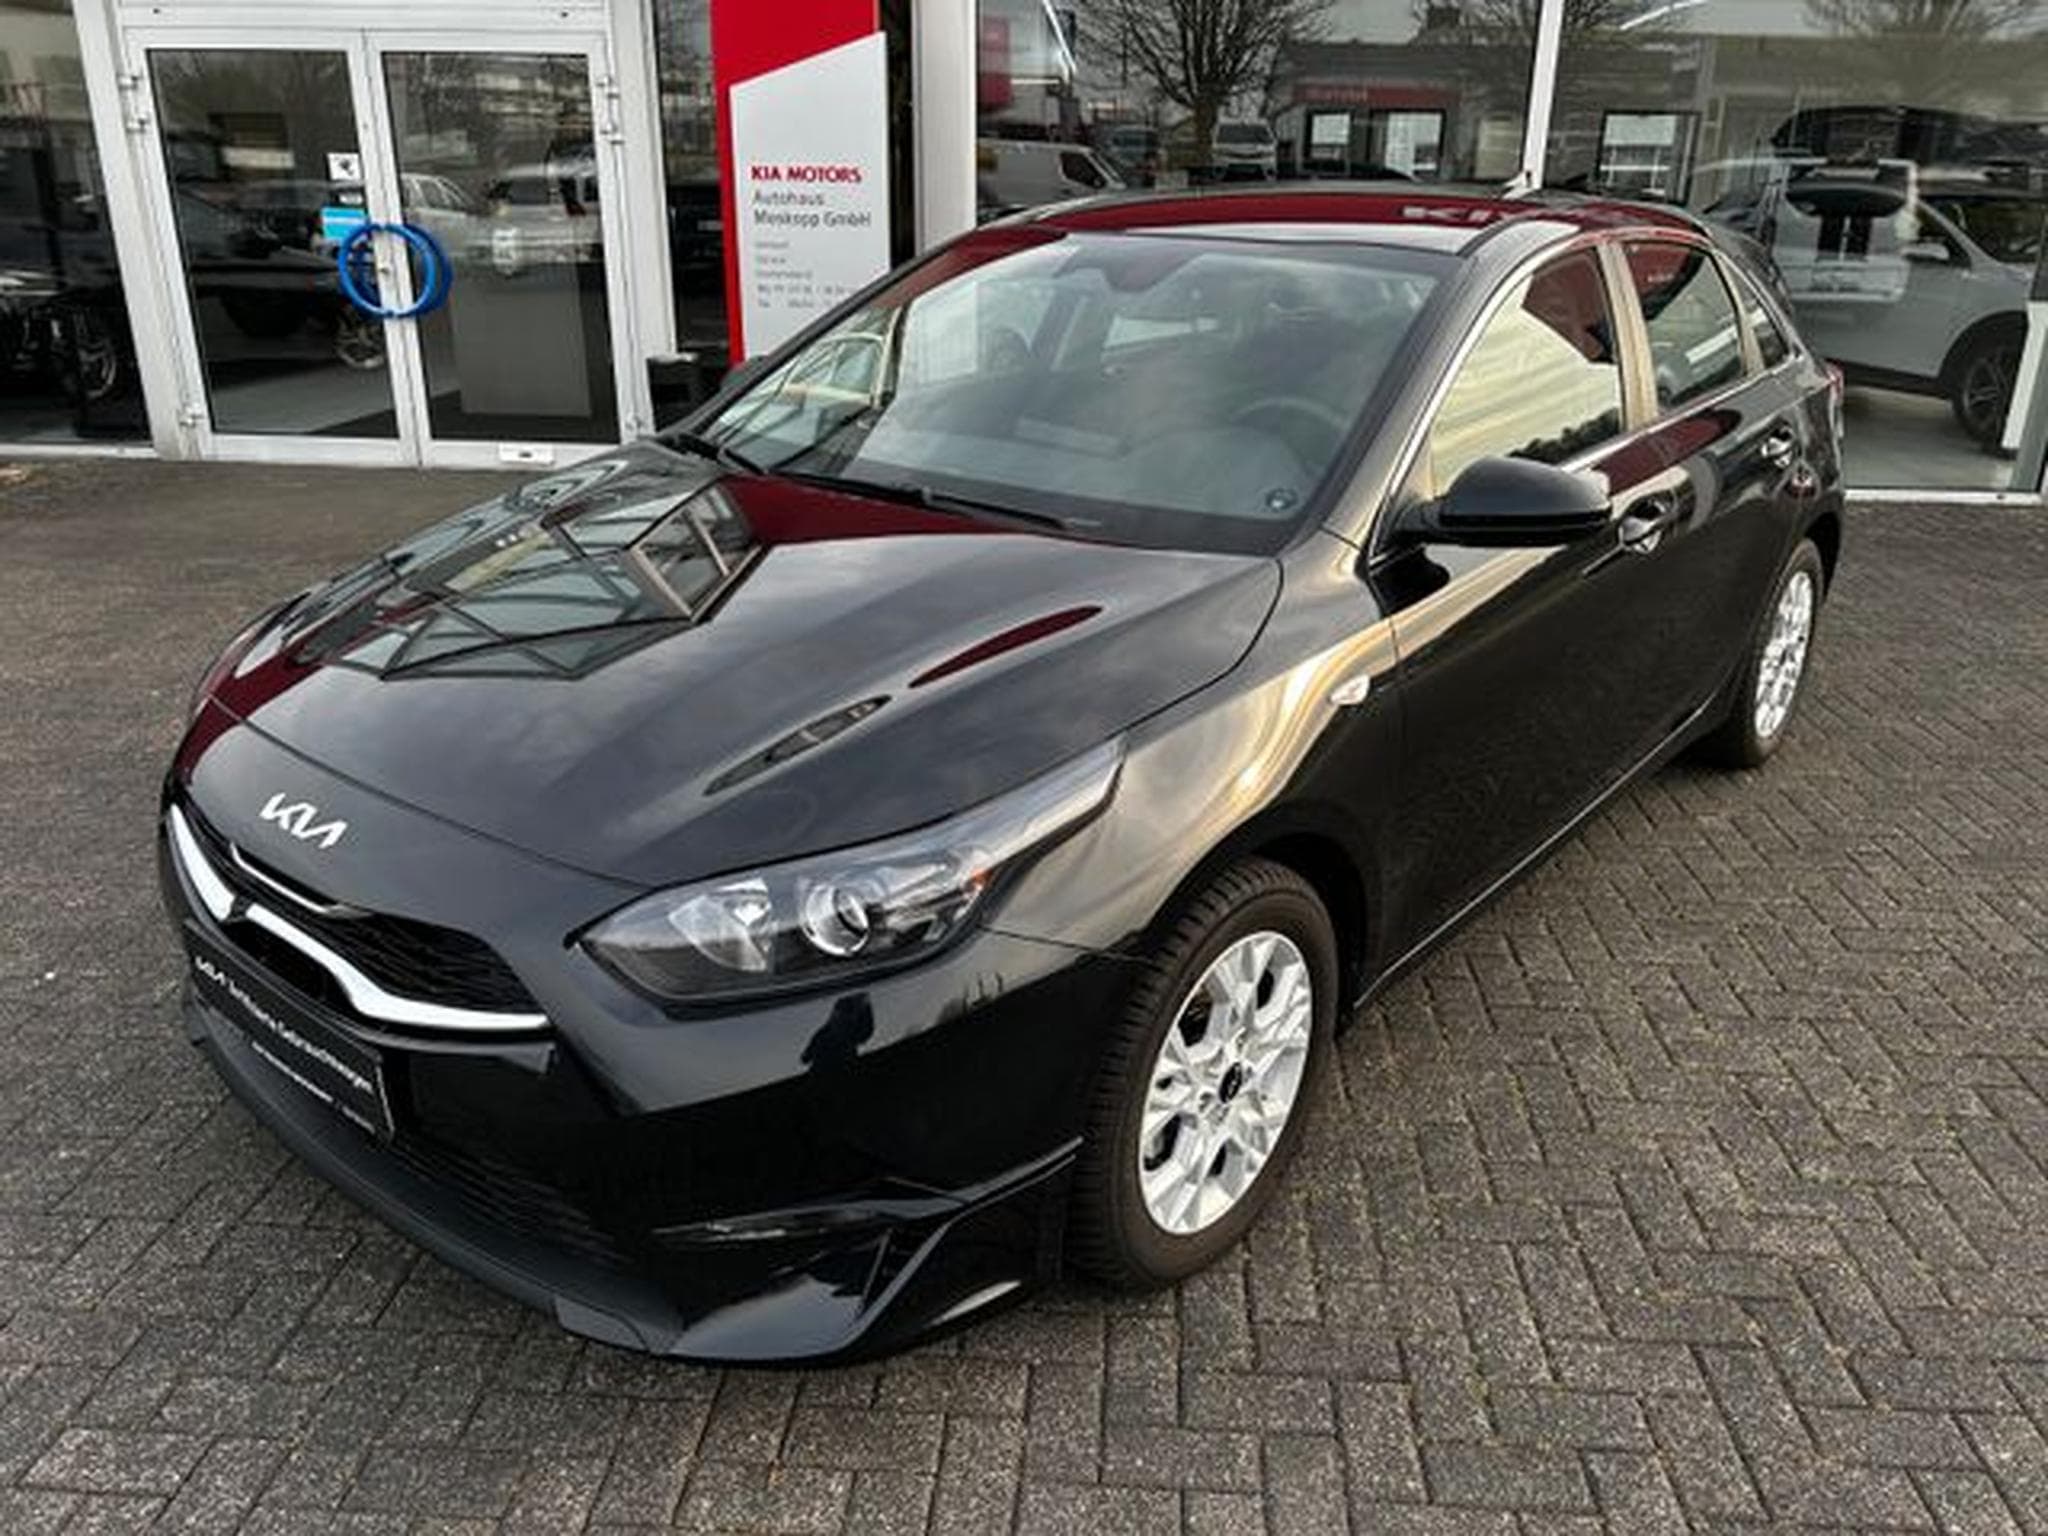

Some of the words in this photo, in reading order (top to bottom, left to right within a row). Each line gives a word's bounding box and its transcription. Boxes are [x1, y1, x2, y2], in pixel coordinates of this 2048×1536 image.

[751, 165, 781, 181] KIA
[786, 165, 862, 183] MOTORS
[753, 189, 825, 206] Autohaus
[823, 209, 871, 228] GmbH
[260, 793, 348, 849] KIA
